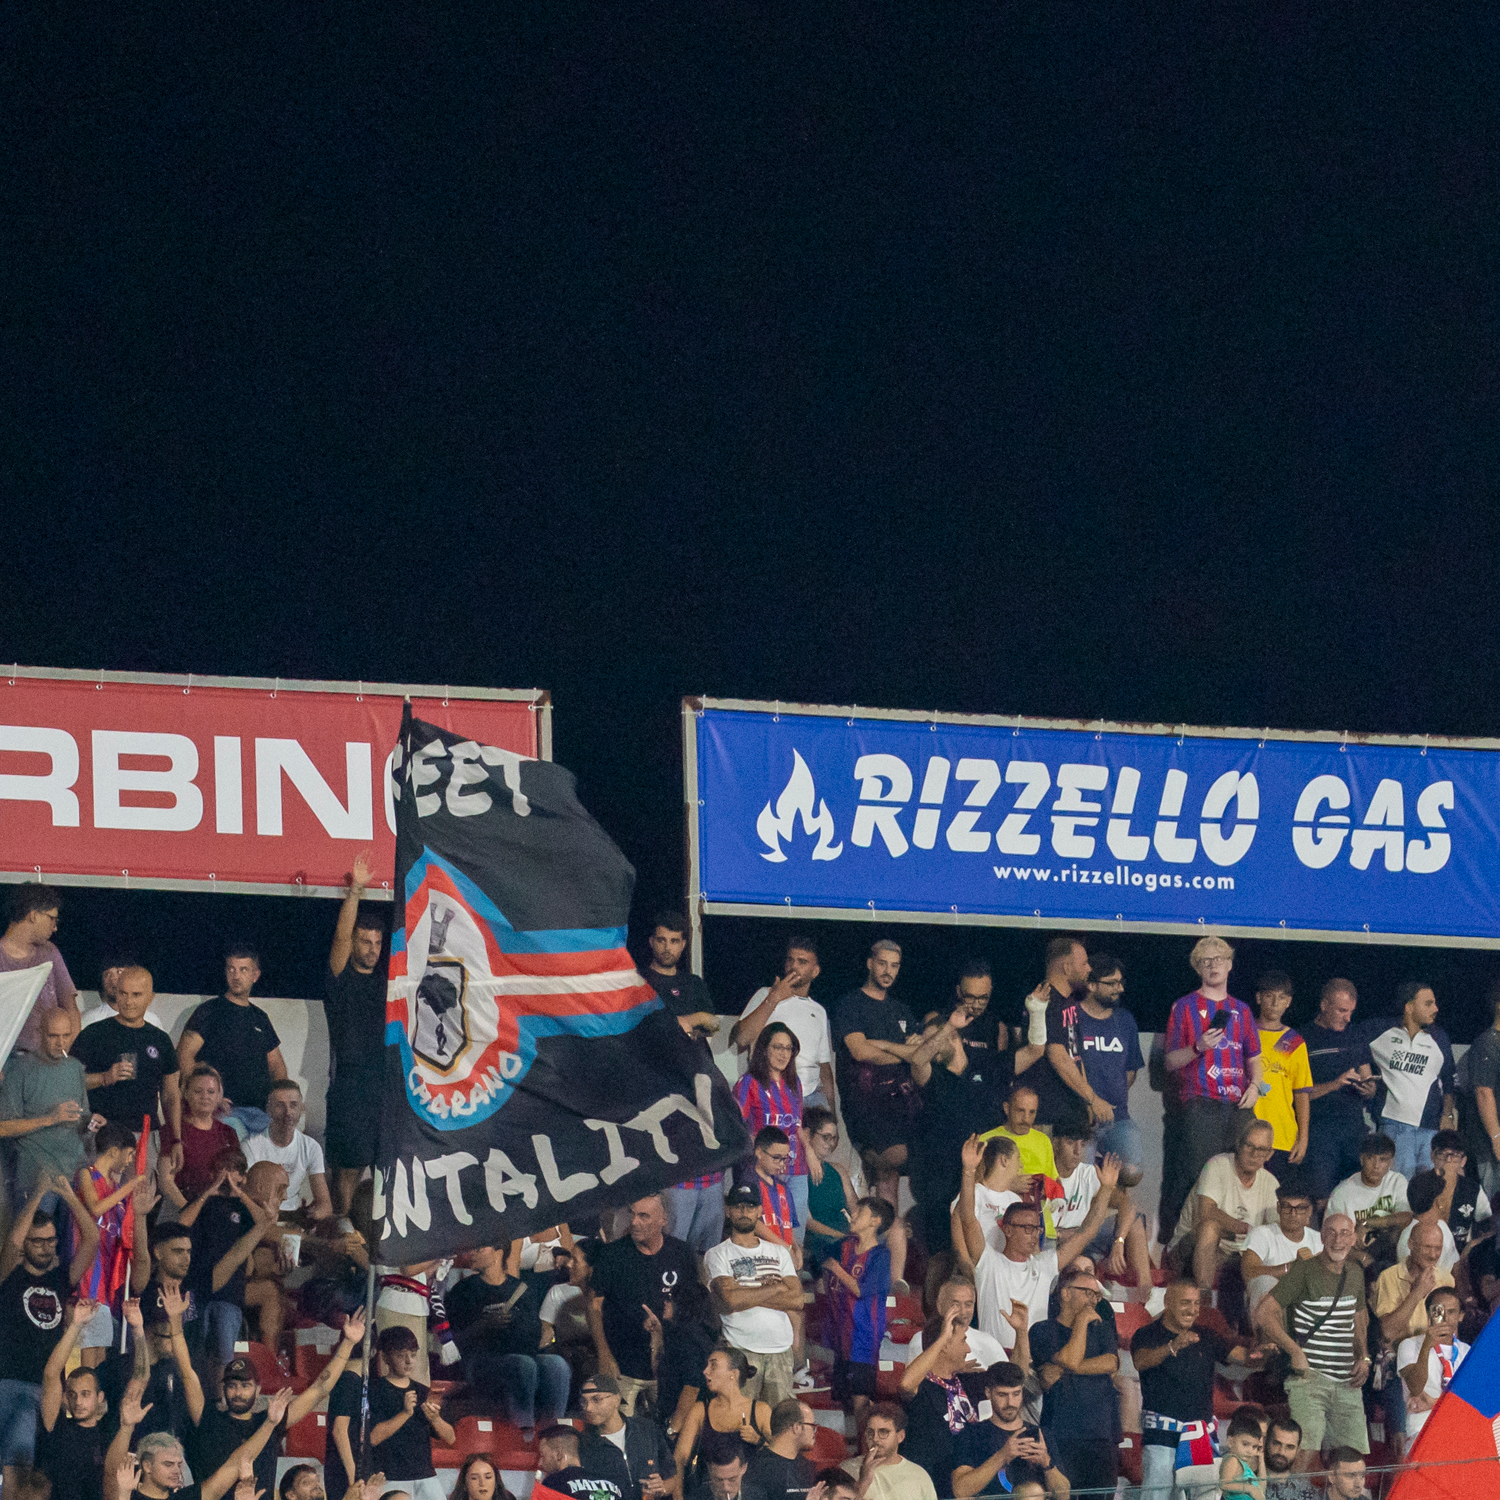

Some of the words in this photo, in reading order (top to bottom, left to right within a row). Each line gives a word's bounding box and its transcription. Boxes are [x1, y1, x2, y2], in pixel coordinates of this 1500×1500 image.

[852, 754, 1259, 866] RIZZELLO
[1292, 774, 1455, 874] GAS
[993, 863, 1235, 891] www.rizzellogas.com
[1083, 1036, 1123, 1052] FILA
[1404, 1051, 1429, 1066] FORM
[1390, 1060, 1426, 1077] BALANCE
